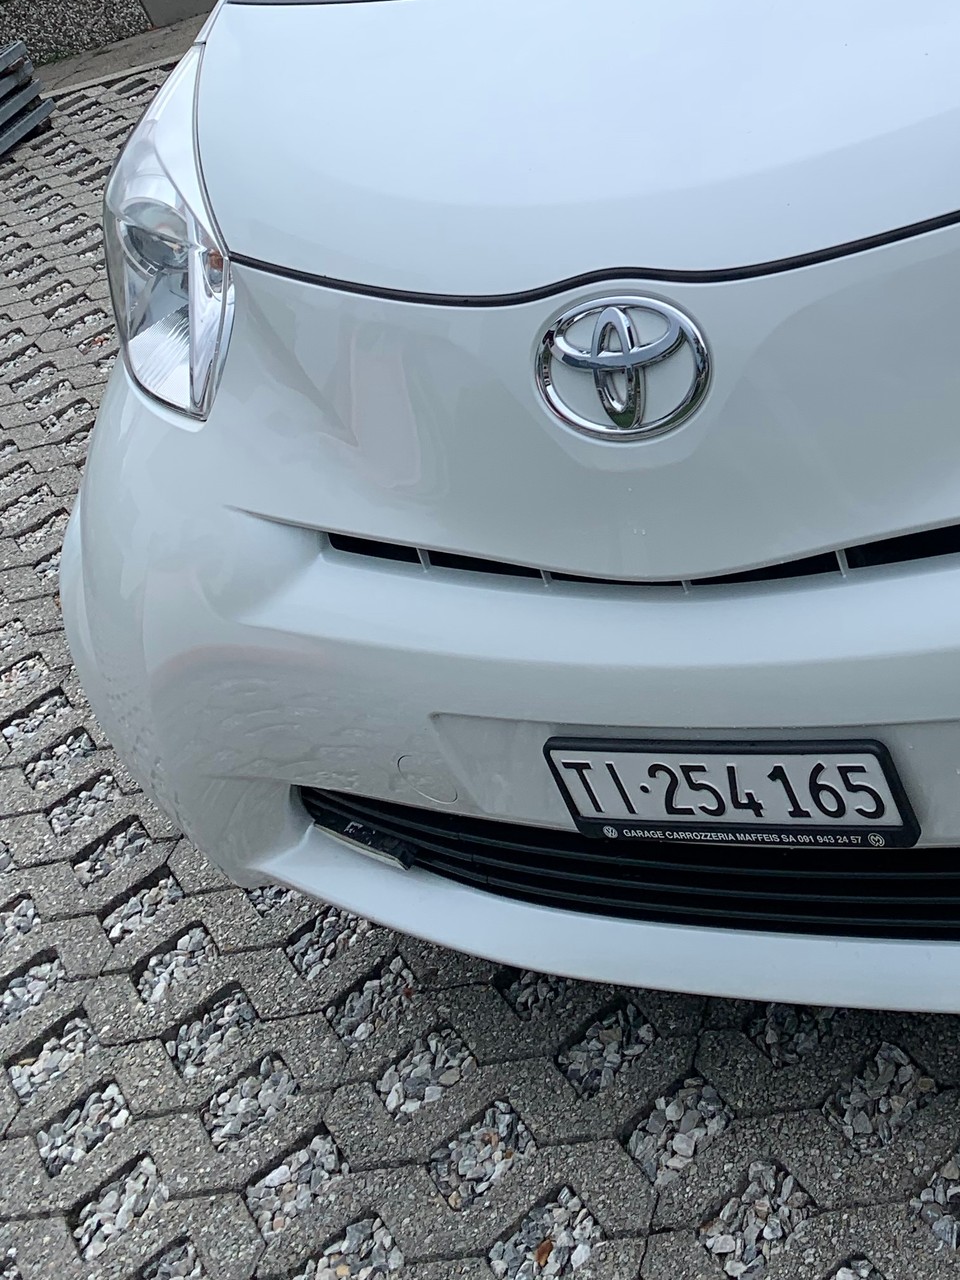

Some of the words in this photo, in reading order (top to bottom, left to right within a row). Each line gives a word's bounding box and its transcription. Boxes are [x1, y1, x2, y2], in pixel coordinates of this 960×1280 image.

[622, 829, 665, 839] GARAGE
[665, 831, 736, 841] CARROZZERIA
[736, 832, 780, 843] MAFFEIS
[780, 834, 797, 843] SA
[797, 835, 815, 844] 091
[816, 835, 835, 844] 943
[836, 835, 849, 844] 24
[850, 836, 862, 844] 57
